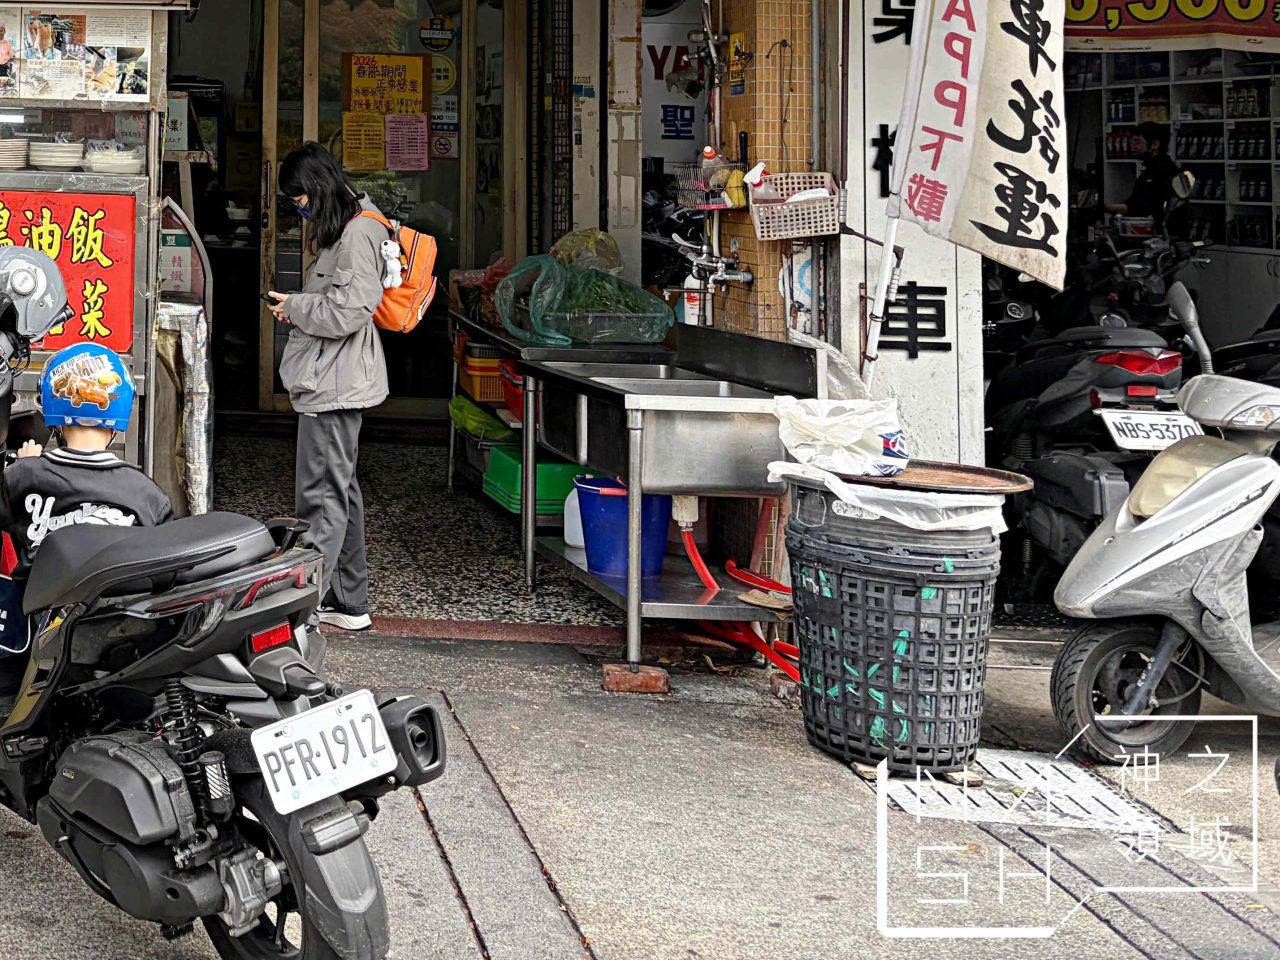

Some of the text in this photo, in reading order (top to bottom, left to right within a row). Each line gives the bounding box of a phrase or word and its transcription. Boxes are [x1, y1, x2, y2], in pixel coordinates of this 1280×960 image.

[352, 55, 377, 66] 2026
[647, 45, 705, 81] YA
[661, 104, 695, 140] 聖
